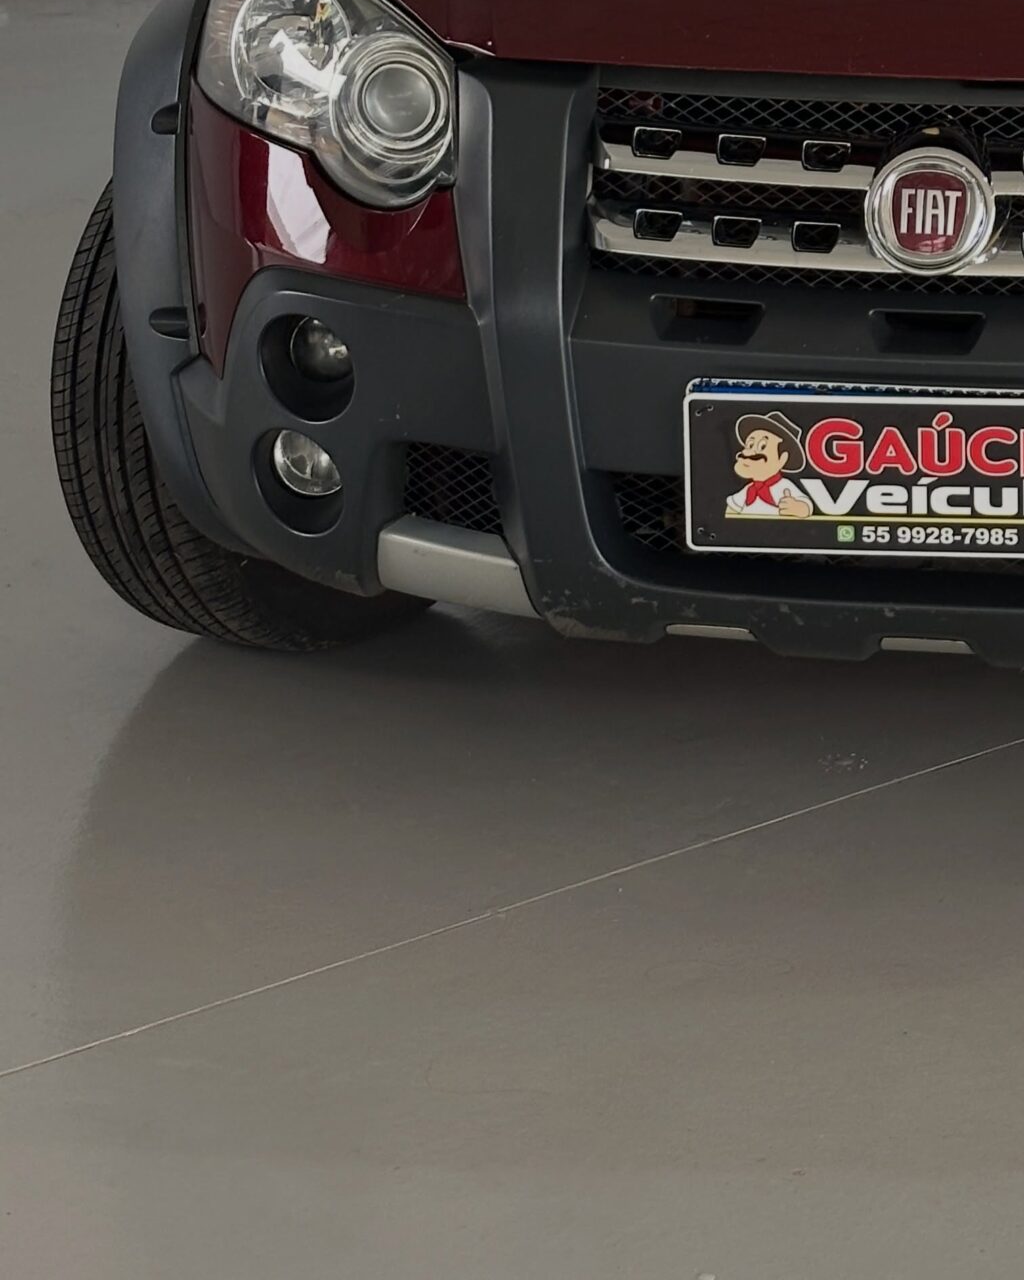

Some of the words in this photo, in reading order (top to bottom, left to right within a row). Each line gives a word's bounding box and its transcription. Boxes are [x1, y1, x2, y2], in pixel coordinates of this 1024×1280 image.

[900, 188, 962, 236] FIAT
[861, 526, 891, 543] 55
[896, 526, 1019, 546] 9928-7985
